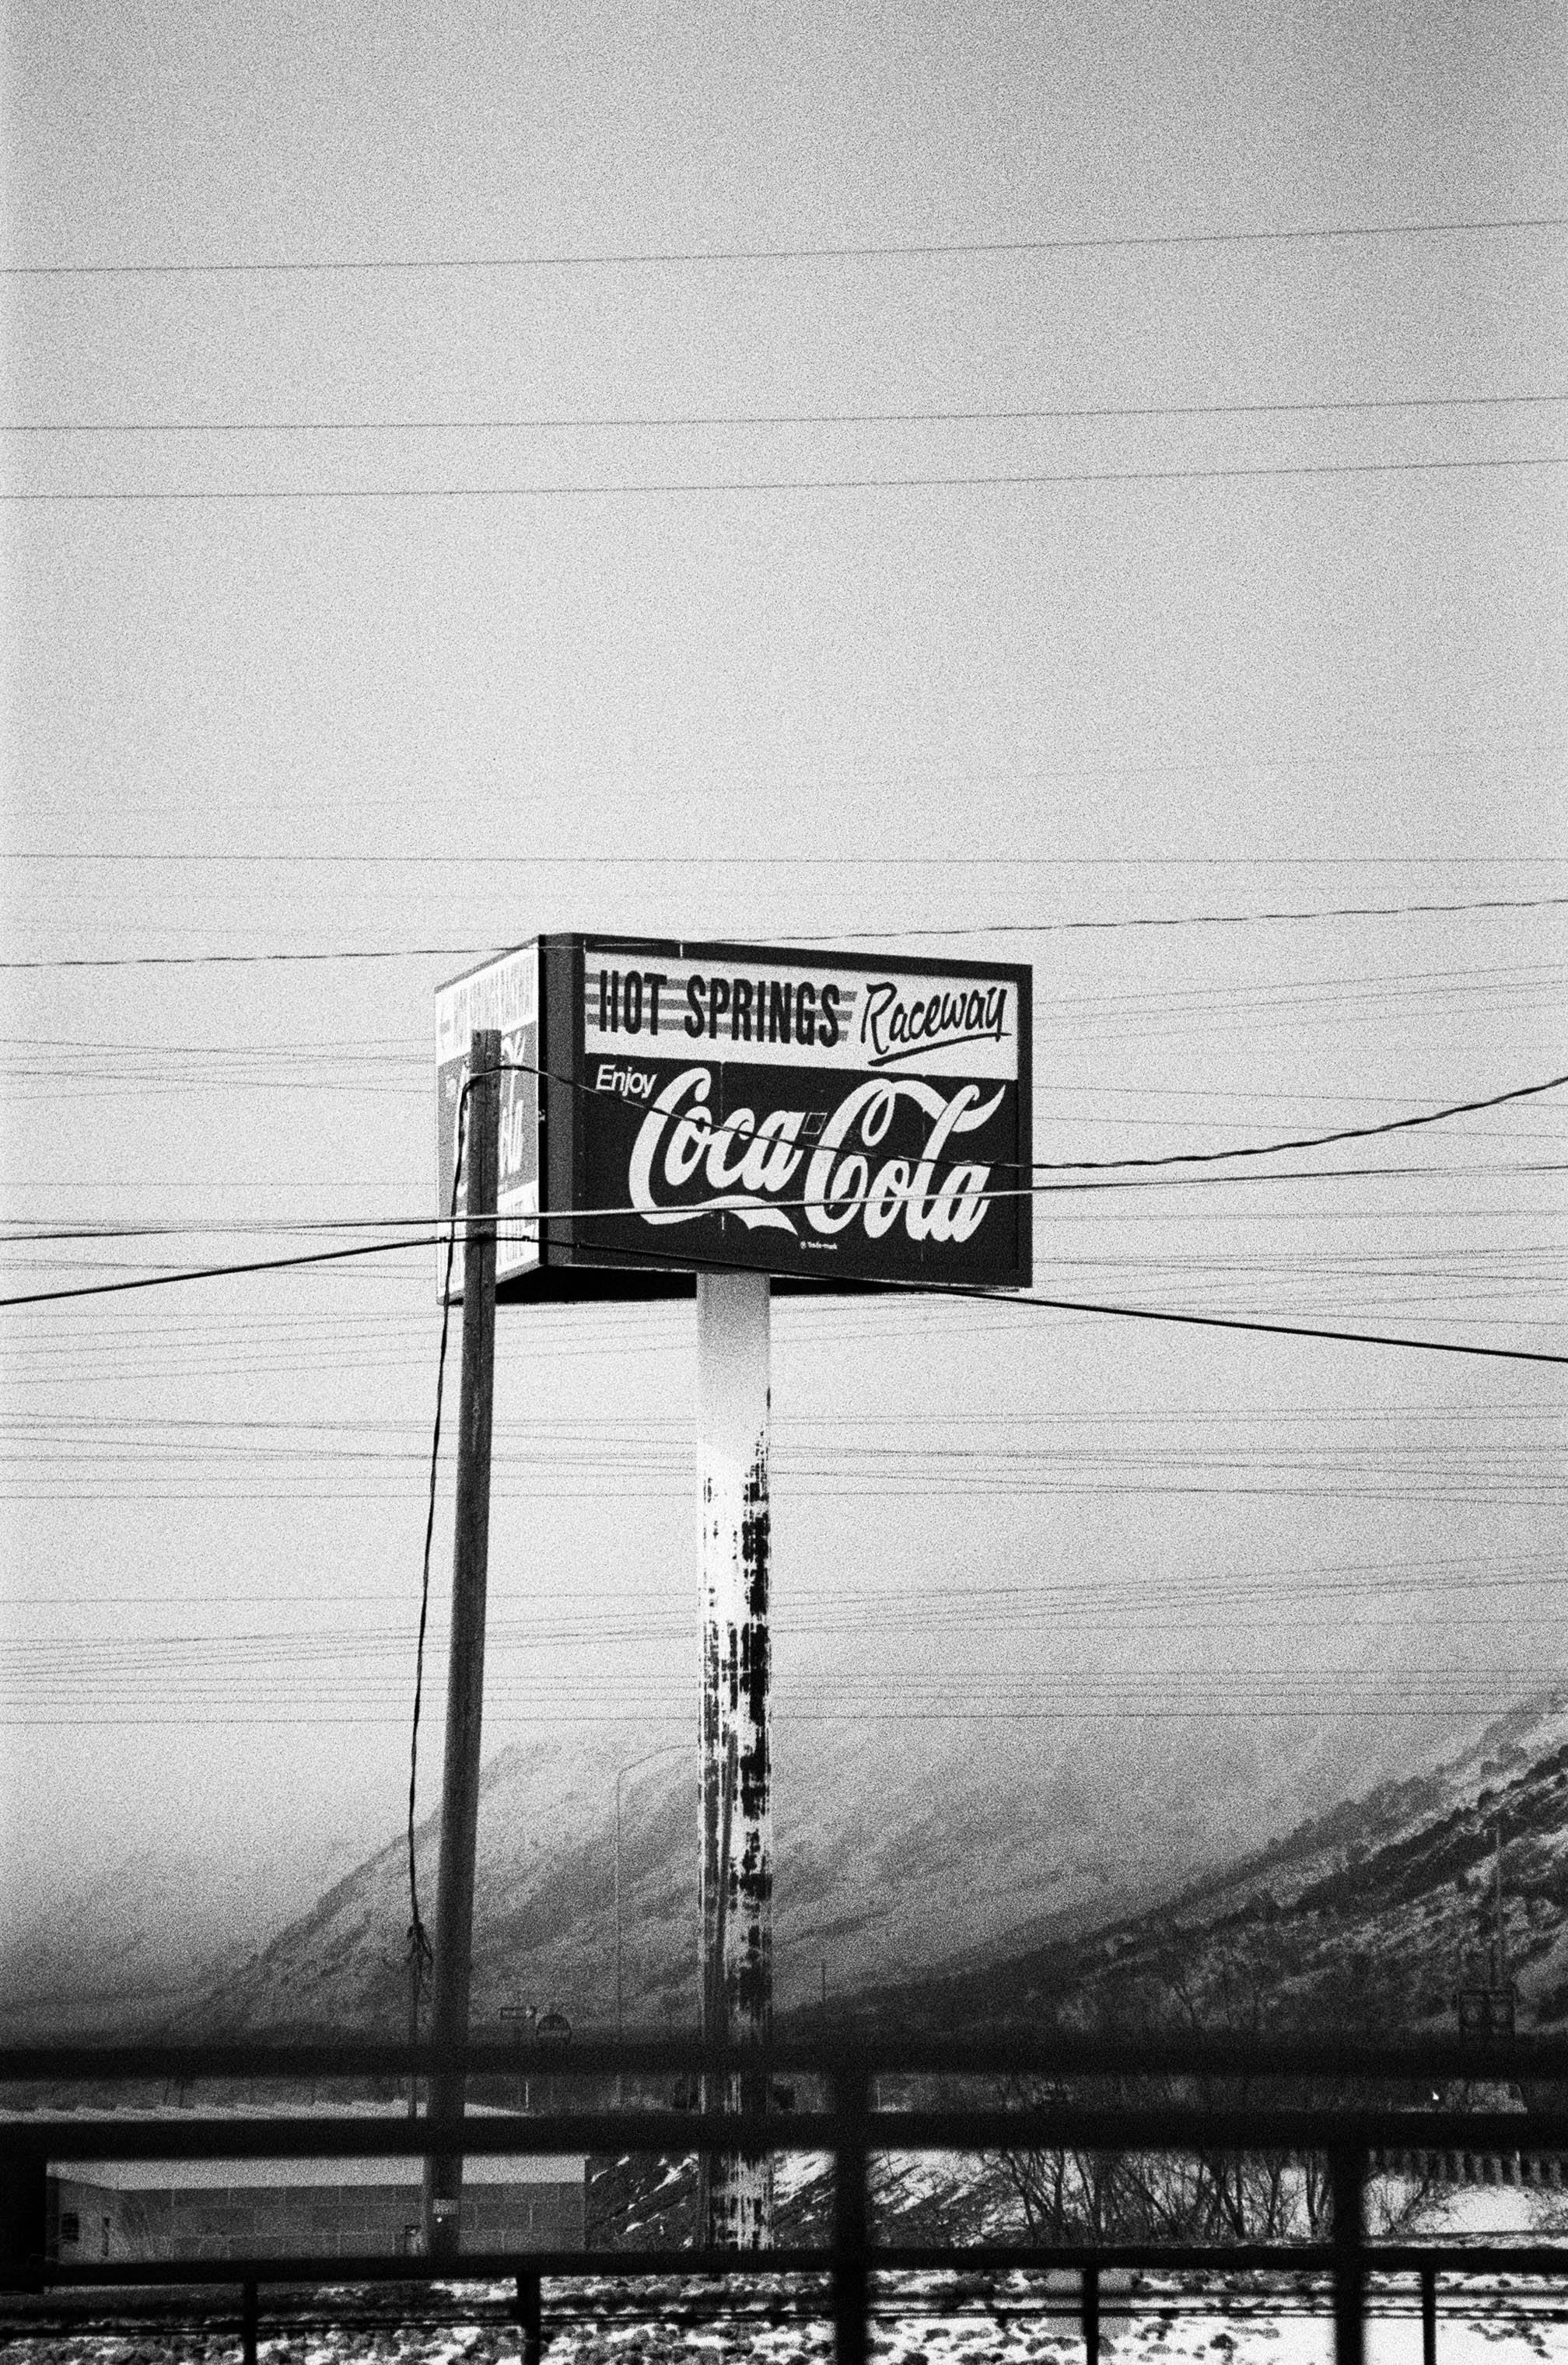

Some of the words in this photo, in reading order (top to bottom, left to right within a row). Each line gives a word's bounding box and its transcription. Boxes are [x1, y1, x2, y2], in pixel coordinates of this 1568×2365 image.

[599, 969, 667, 1036] HOT
[684, 974, 841, 1048] SPRINGS
[860, 981, 1008, 1055] Raceway
[596, 1064, 658, 1099] Enjoy
